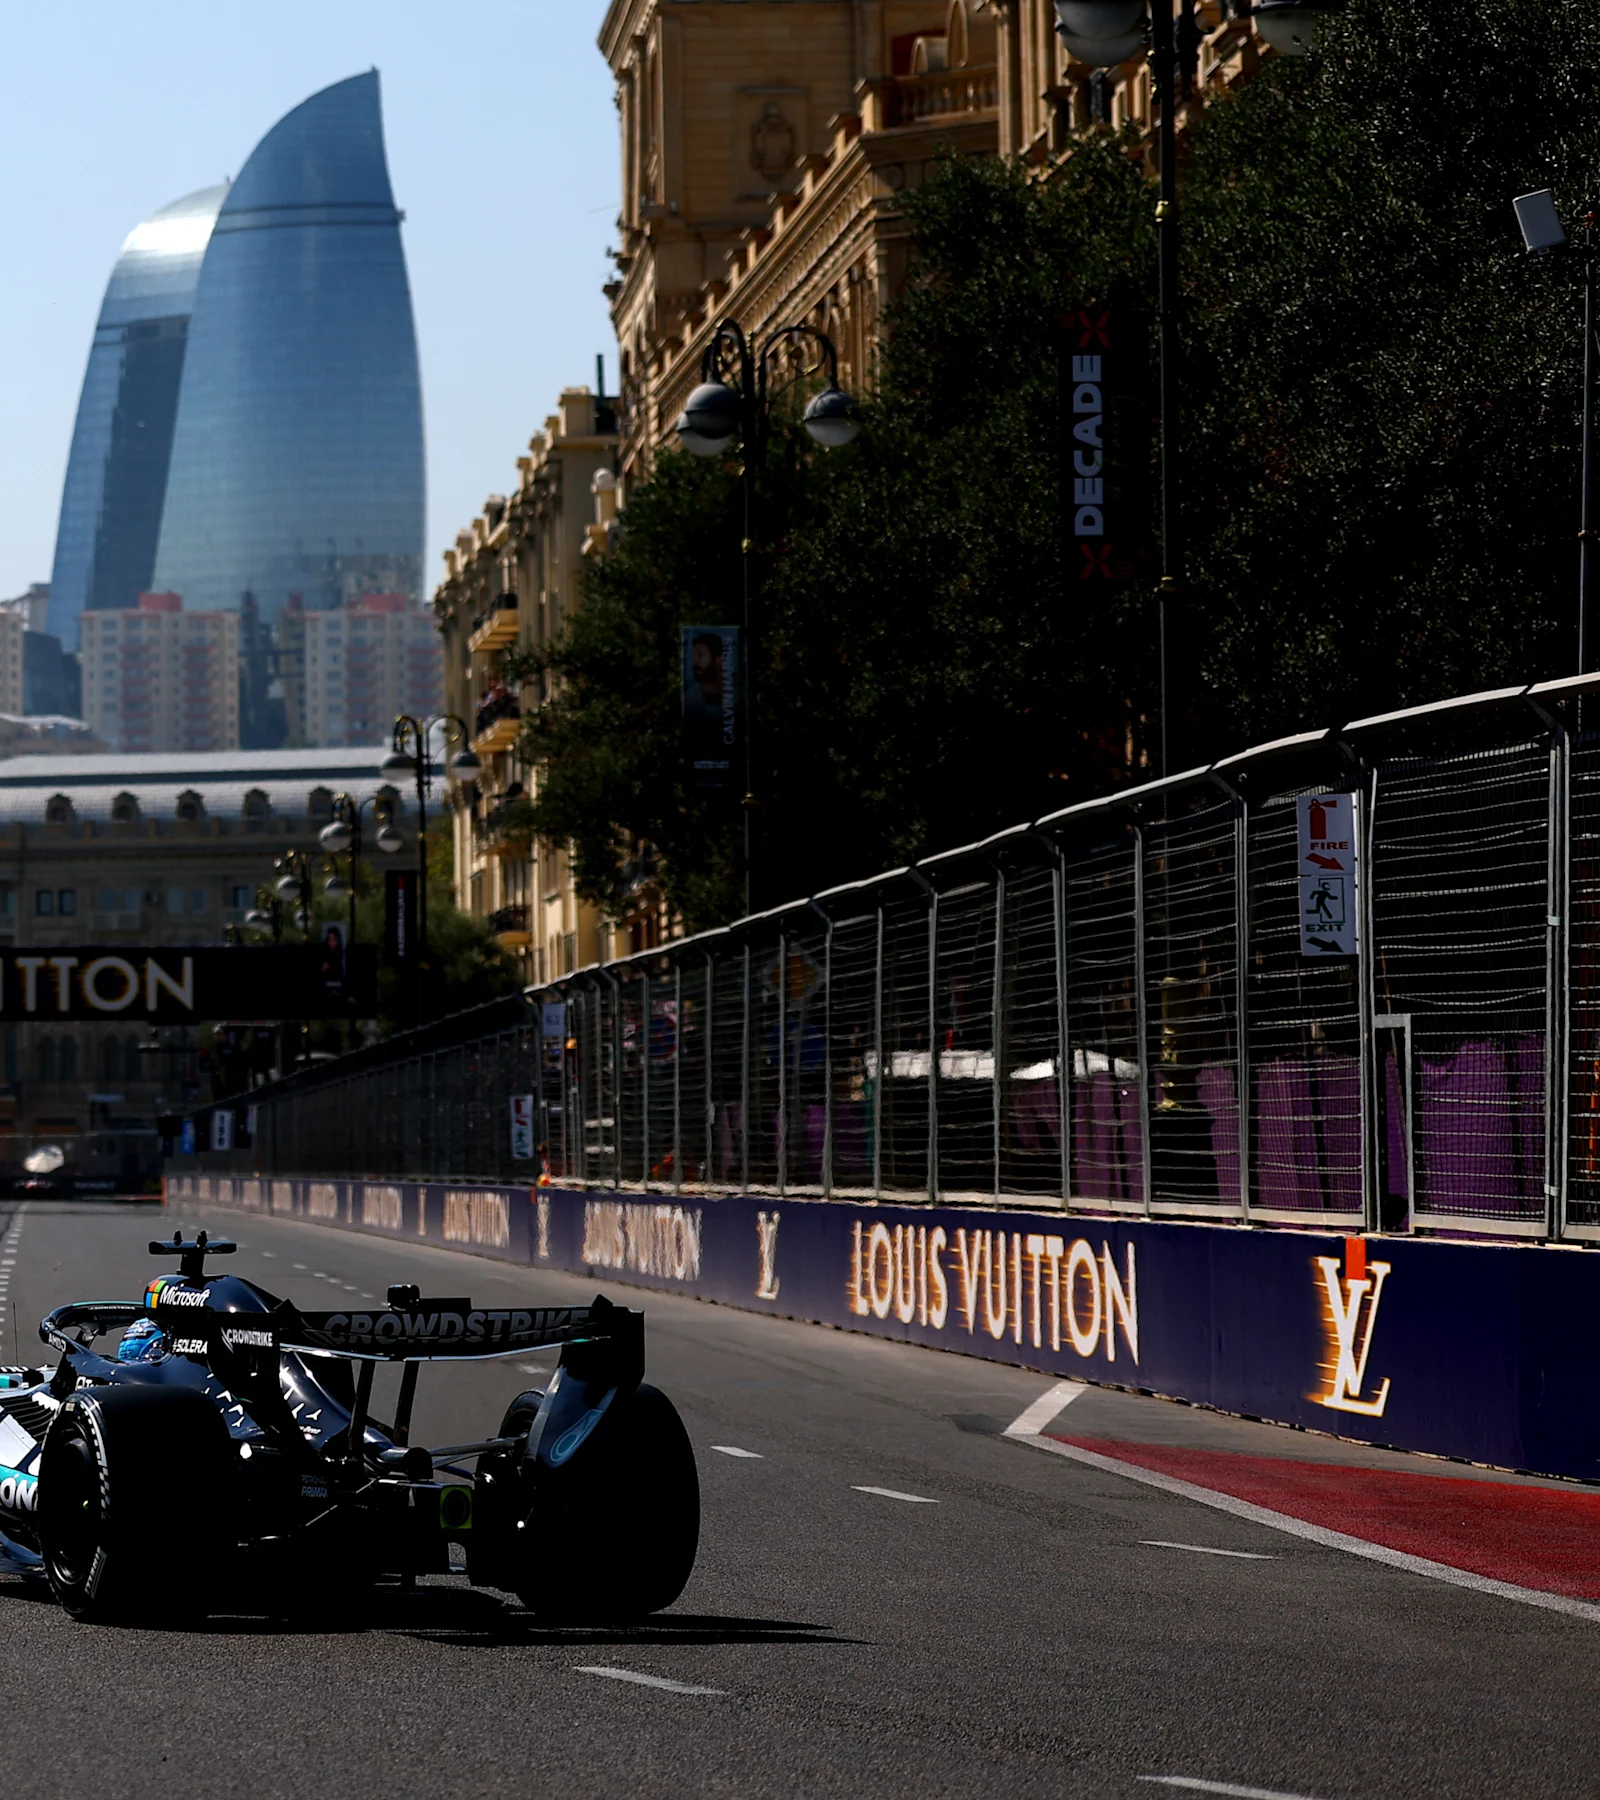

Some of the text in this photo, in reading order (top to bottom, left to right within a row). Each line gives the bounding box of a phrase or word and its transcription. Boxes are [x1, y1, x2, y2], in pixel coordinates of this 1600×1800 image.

[1072, 353, 1104, 537] DECADE
[1310, 841, 1349, 850] FIRE
[1305, 923, 1345, 932] EXIT
[159, 1284, 211, 1308] Microsoft
[852, 1219, 1140, 1367] LOUIS VUITTON
[227, 1328, 274, 1348] CROWDSTRIKE
[323, 1309, 591, 1346] CROWDSTRIKE
[176, 1339, 208, 1355] SOLERA
